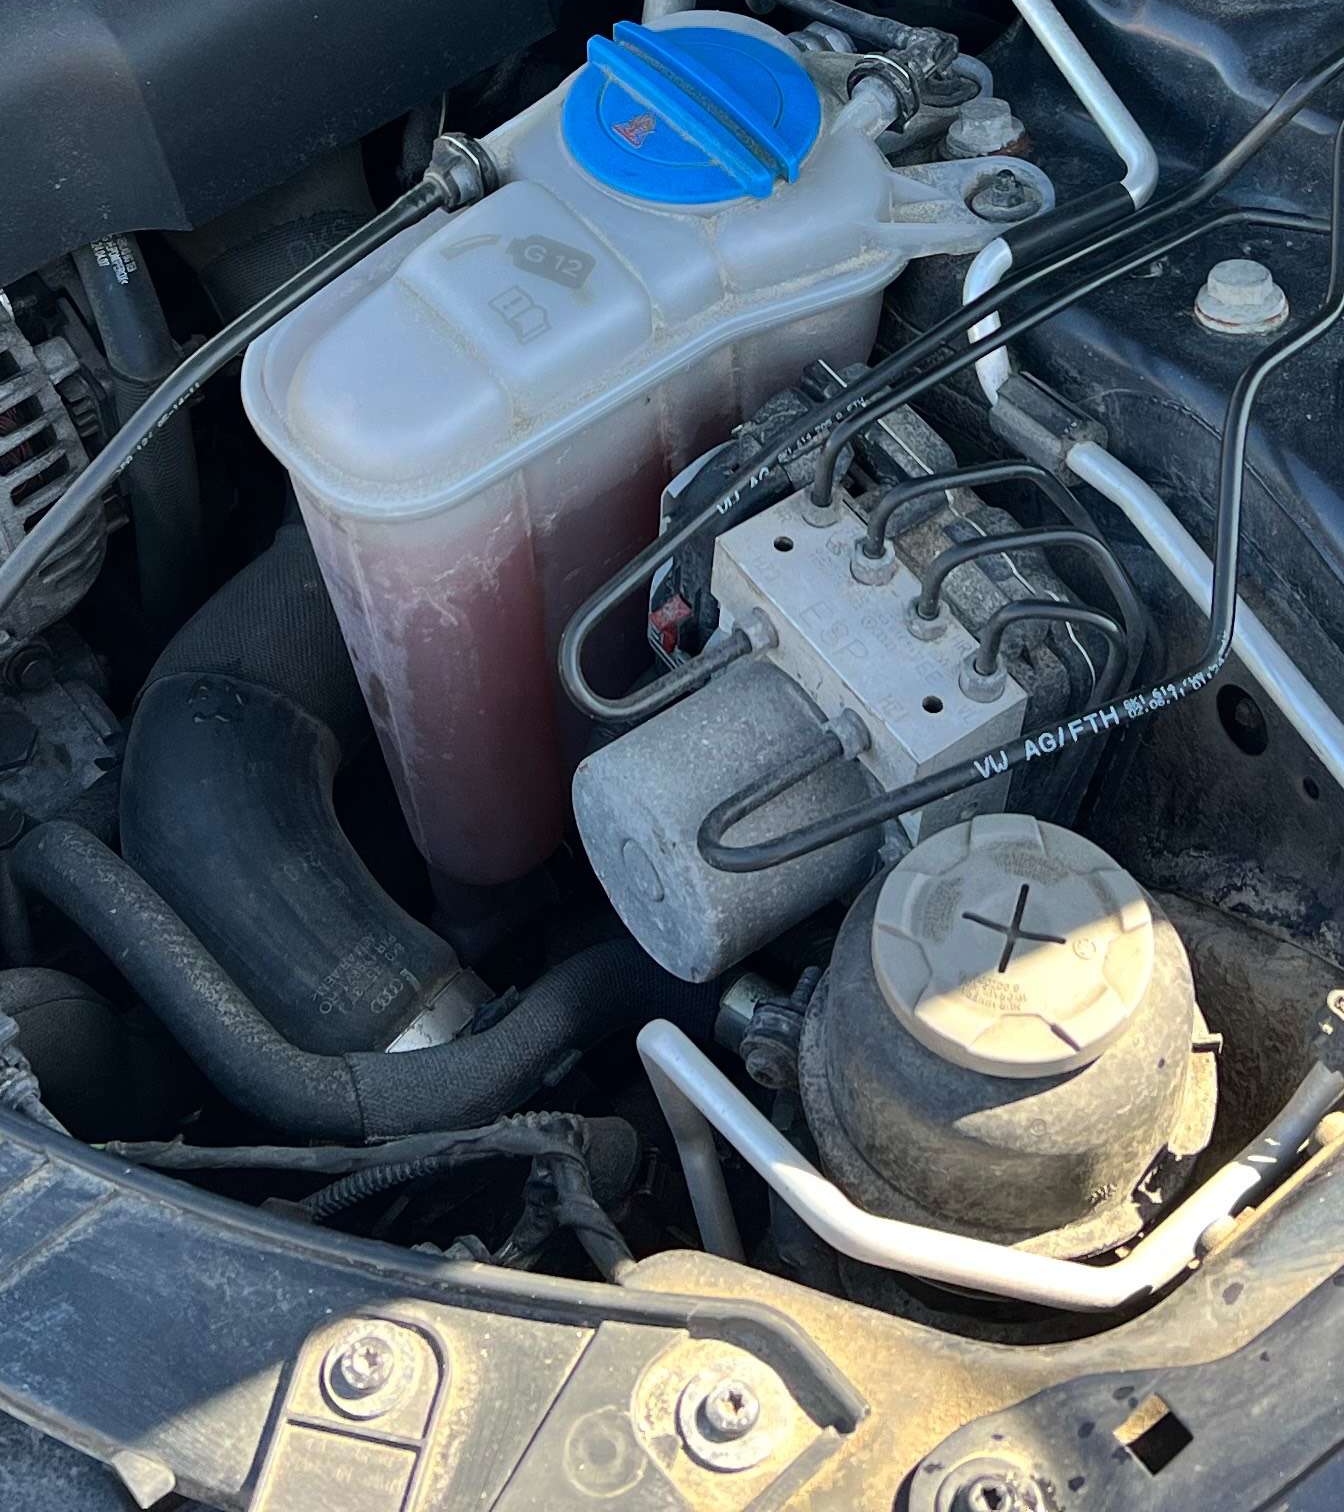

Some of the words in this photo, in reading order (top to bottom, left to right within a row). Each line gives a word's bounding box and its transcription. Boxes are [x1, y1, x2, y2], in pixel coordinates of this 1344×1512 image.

[524, 243, 547, 263] G
[555, 254, 583, 278] 12
[973, 750, 1009, 779] VW
[1023, 705, 1121, 762] AG/FTH
